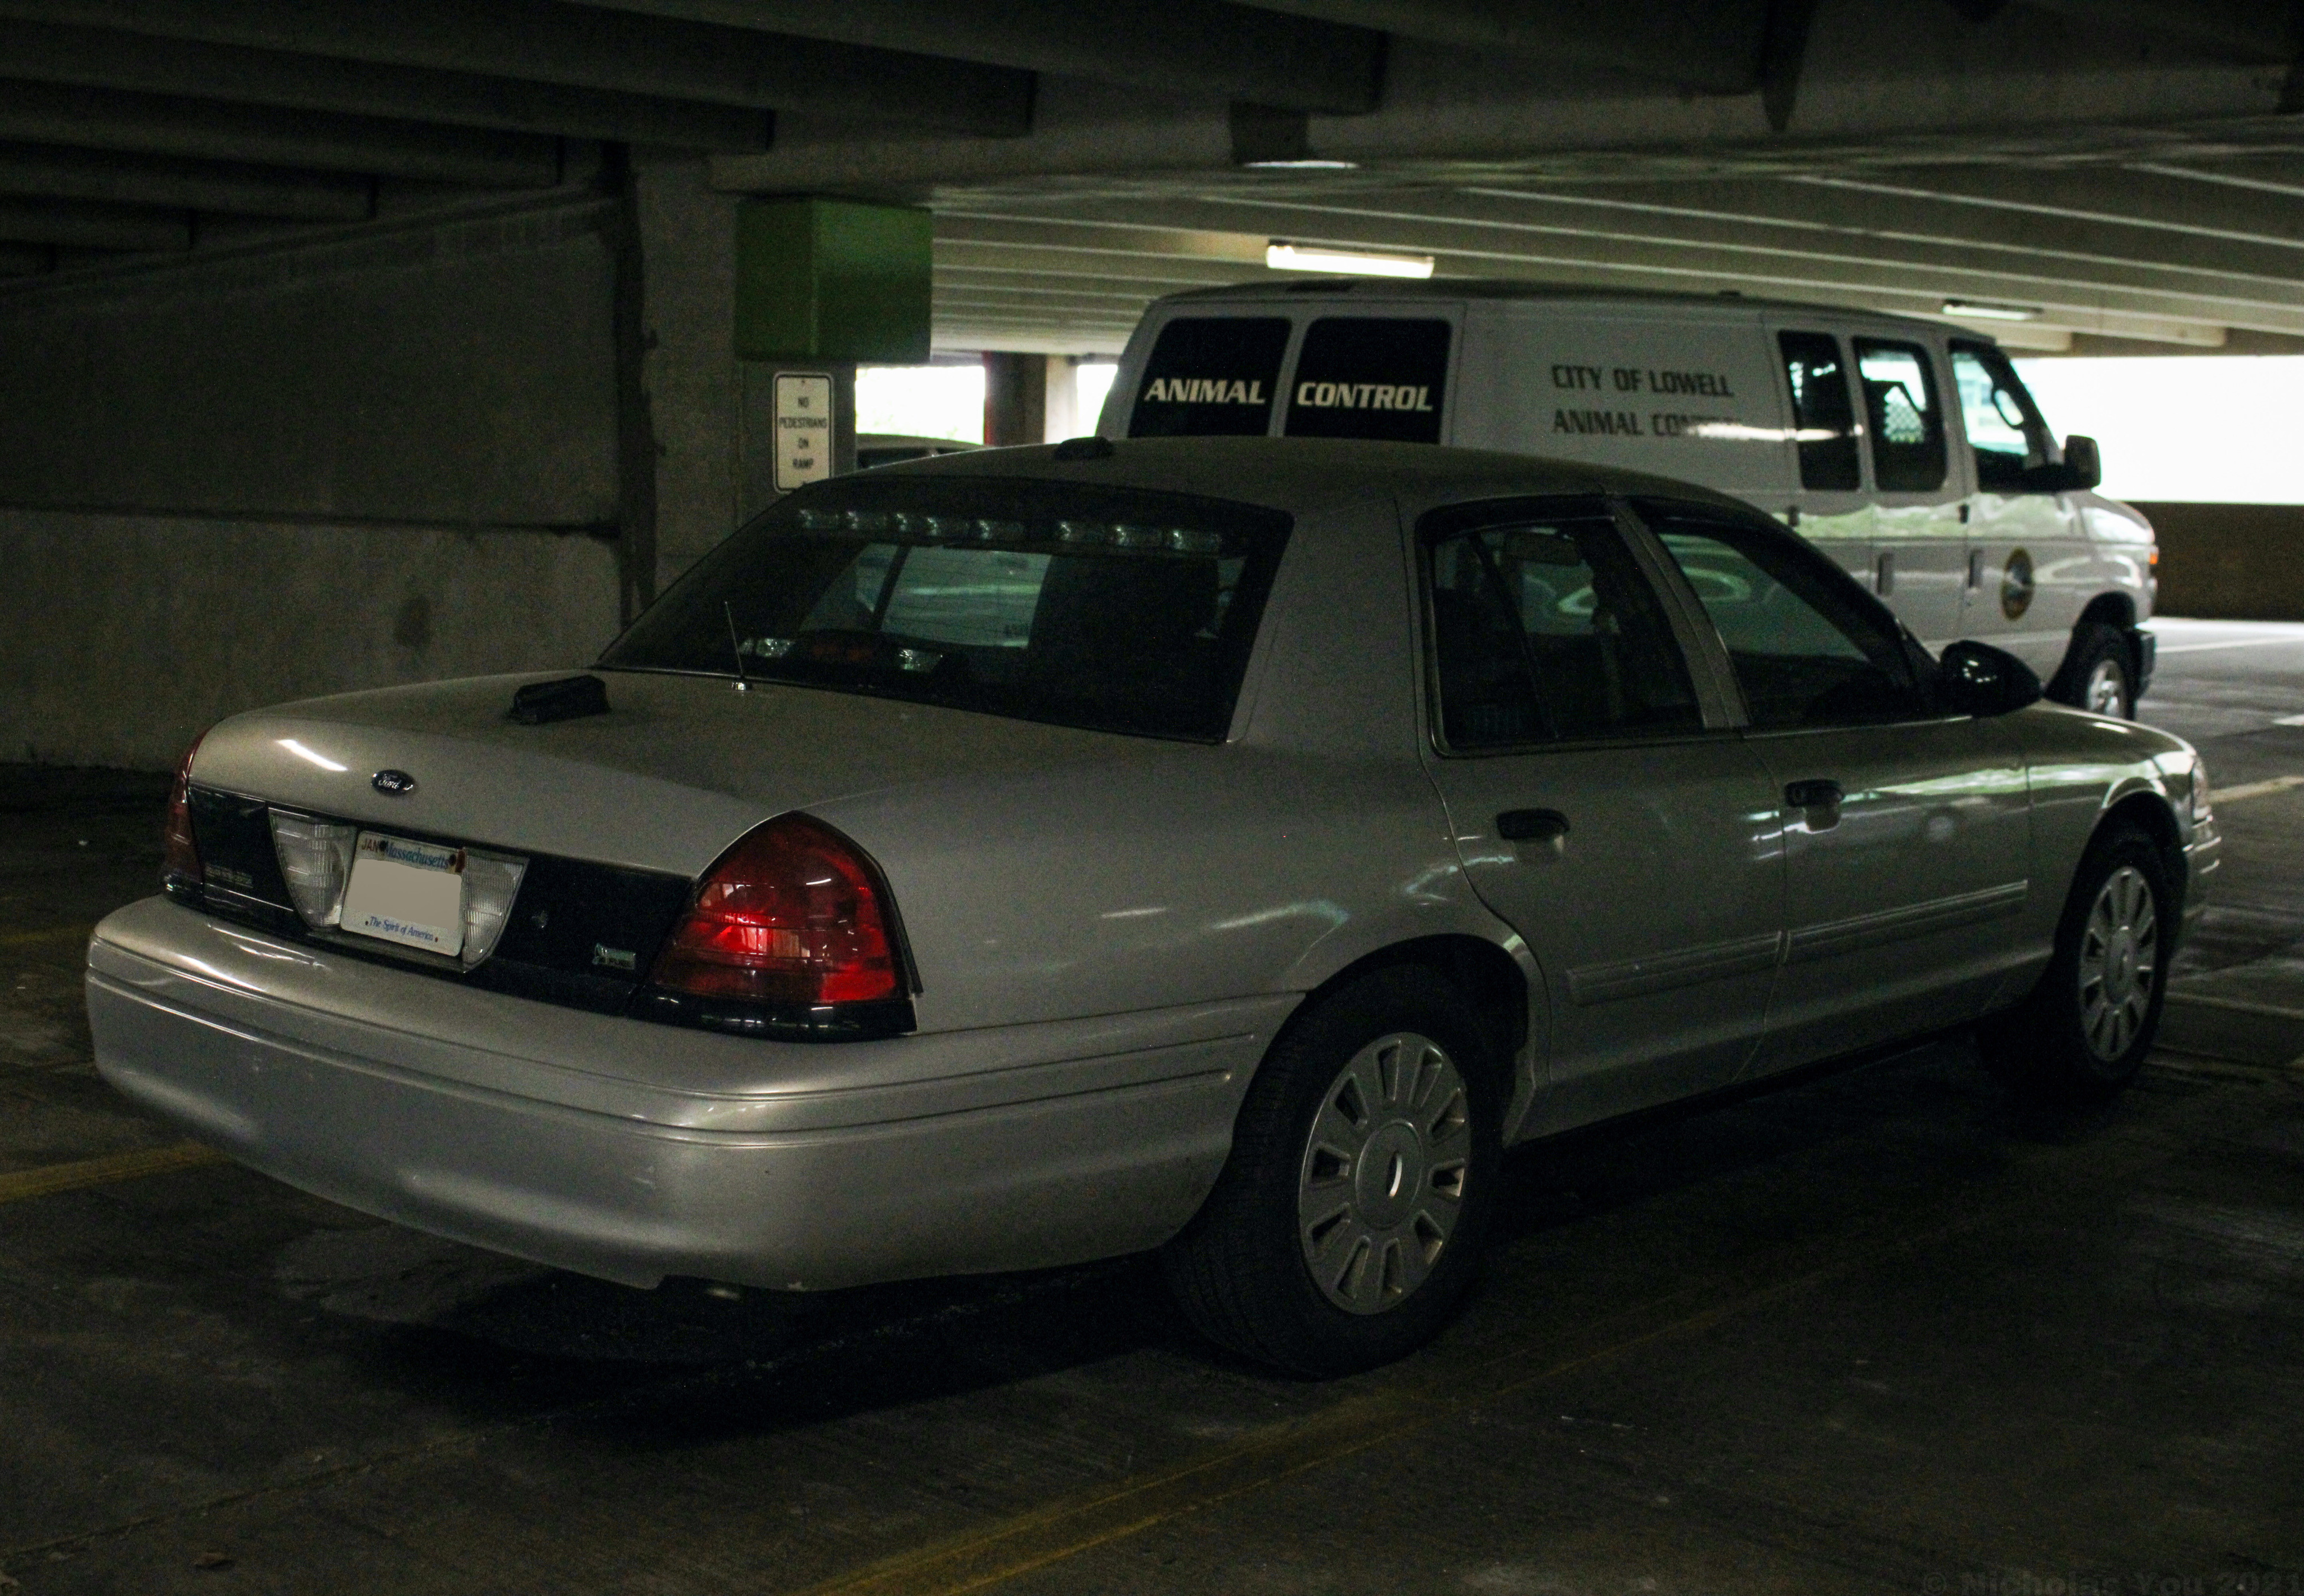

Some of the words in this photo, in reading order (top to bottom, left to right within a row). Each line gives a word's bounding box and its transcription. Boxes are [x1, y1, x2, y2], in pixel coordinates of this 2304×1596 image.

[1551, 365, 1601, 390] CITY
[1613, 368, 1640, 392] OF
[1649, 370, 1735, 397] LOWELL
[1144, 378, 1266, 404] ANIMAL
[1297, 382, 1433, 411] CONTROL
[778, 416, 827, 429] PEDESTRIANS
[1552, 409, 1644, 435] ANIMAL
[793, 458, 814, 469] RAMP
[385, 843, 449, 869] Massachusetts
[370, 915, 381, 927] The
[383, 919, 400, 932] Spirit
[400, 924, 408, 936] of
[407, 926, 433, 941] America
